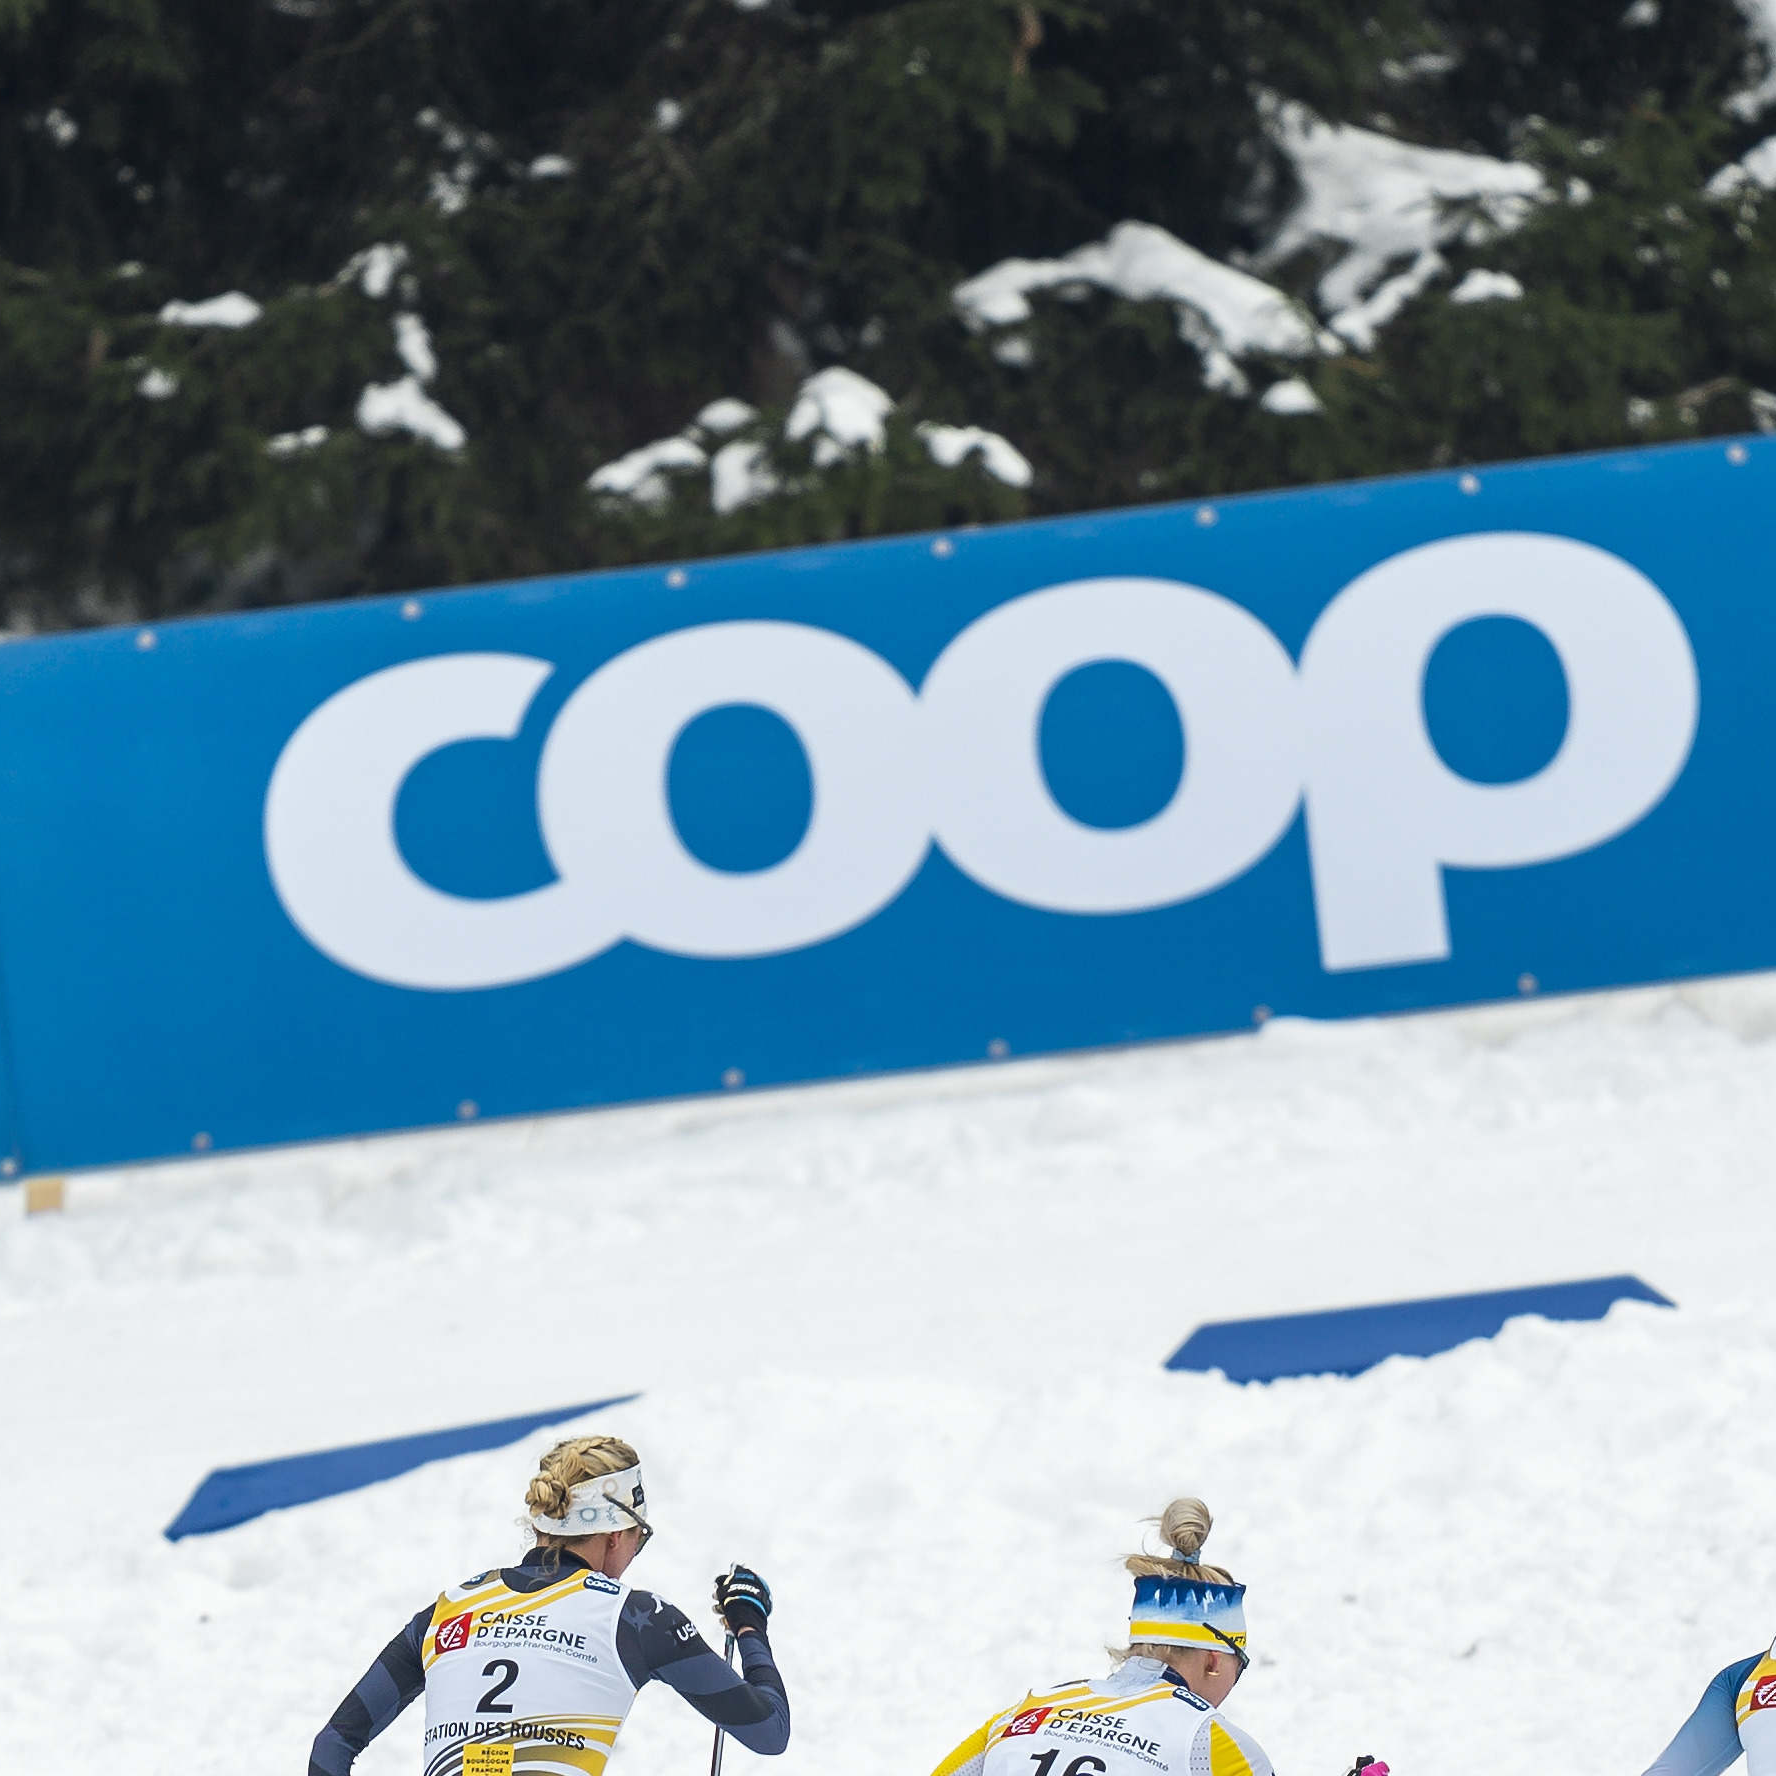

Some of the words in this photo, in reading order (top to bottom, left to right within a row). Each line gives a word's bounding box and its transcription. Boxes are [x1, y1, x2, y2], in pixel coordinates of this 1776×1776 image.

[264, 531, 1700, 991] coop
[585, 1577, 619, 1594] coop
[480, 1611, 548, 1627] CAISSE
[476, 1626, 587, 1650] D'EPARGNE
[473, 1640, 522, 1650] Bourgogne
[523, 1640, 598, 1664] Franche-Comté
[475, 1658, 520, 1714] 2
[1058, 1708, 1127, 1729] CAISSE
[424, 1721, 470, 1747] STATION
[475, 1721, 506, 1738] DES
[510, 1722, 586, 1751] ROUSSES
[1049, 1720, 1161, 1757] D'EPARGNE
[1043, 1728, 1094, 1744] Bourgogne
[1095, 1739, 1169, 1773] Franche-Comté
